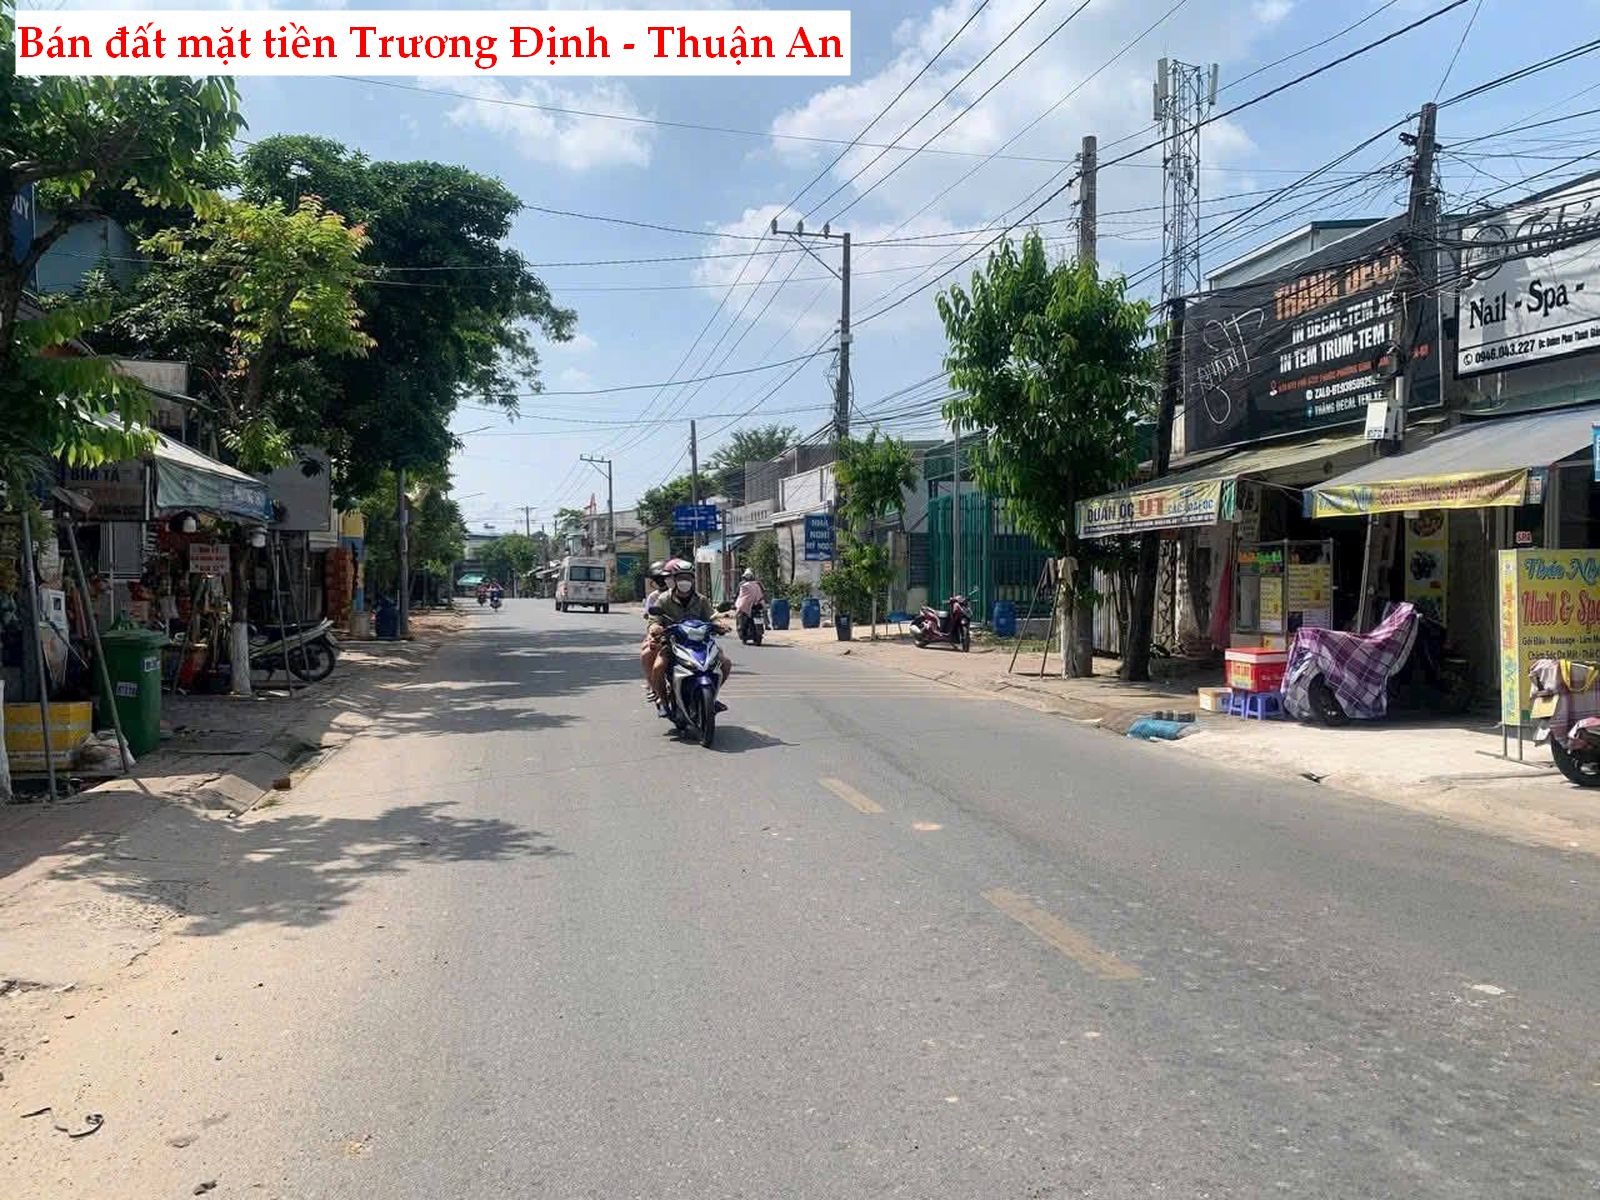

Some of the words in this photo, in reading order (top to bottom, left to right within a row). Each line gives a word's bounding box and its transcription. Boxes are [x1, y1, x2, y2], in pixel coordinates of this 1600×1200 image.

[1469, 290, 1507, 329] Nail
[1527, 279, 1569, 317] Spa
[1279, 352, 1292, 374] IN
[1293, 345, 1318, 369] TEM
